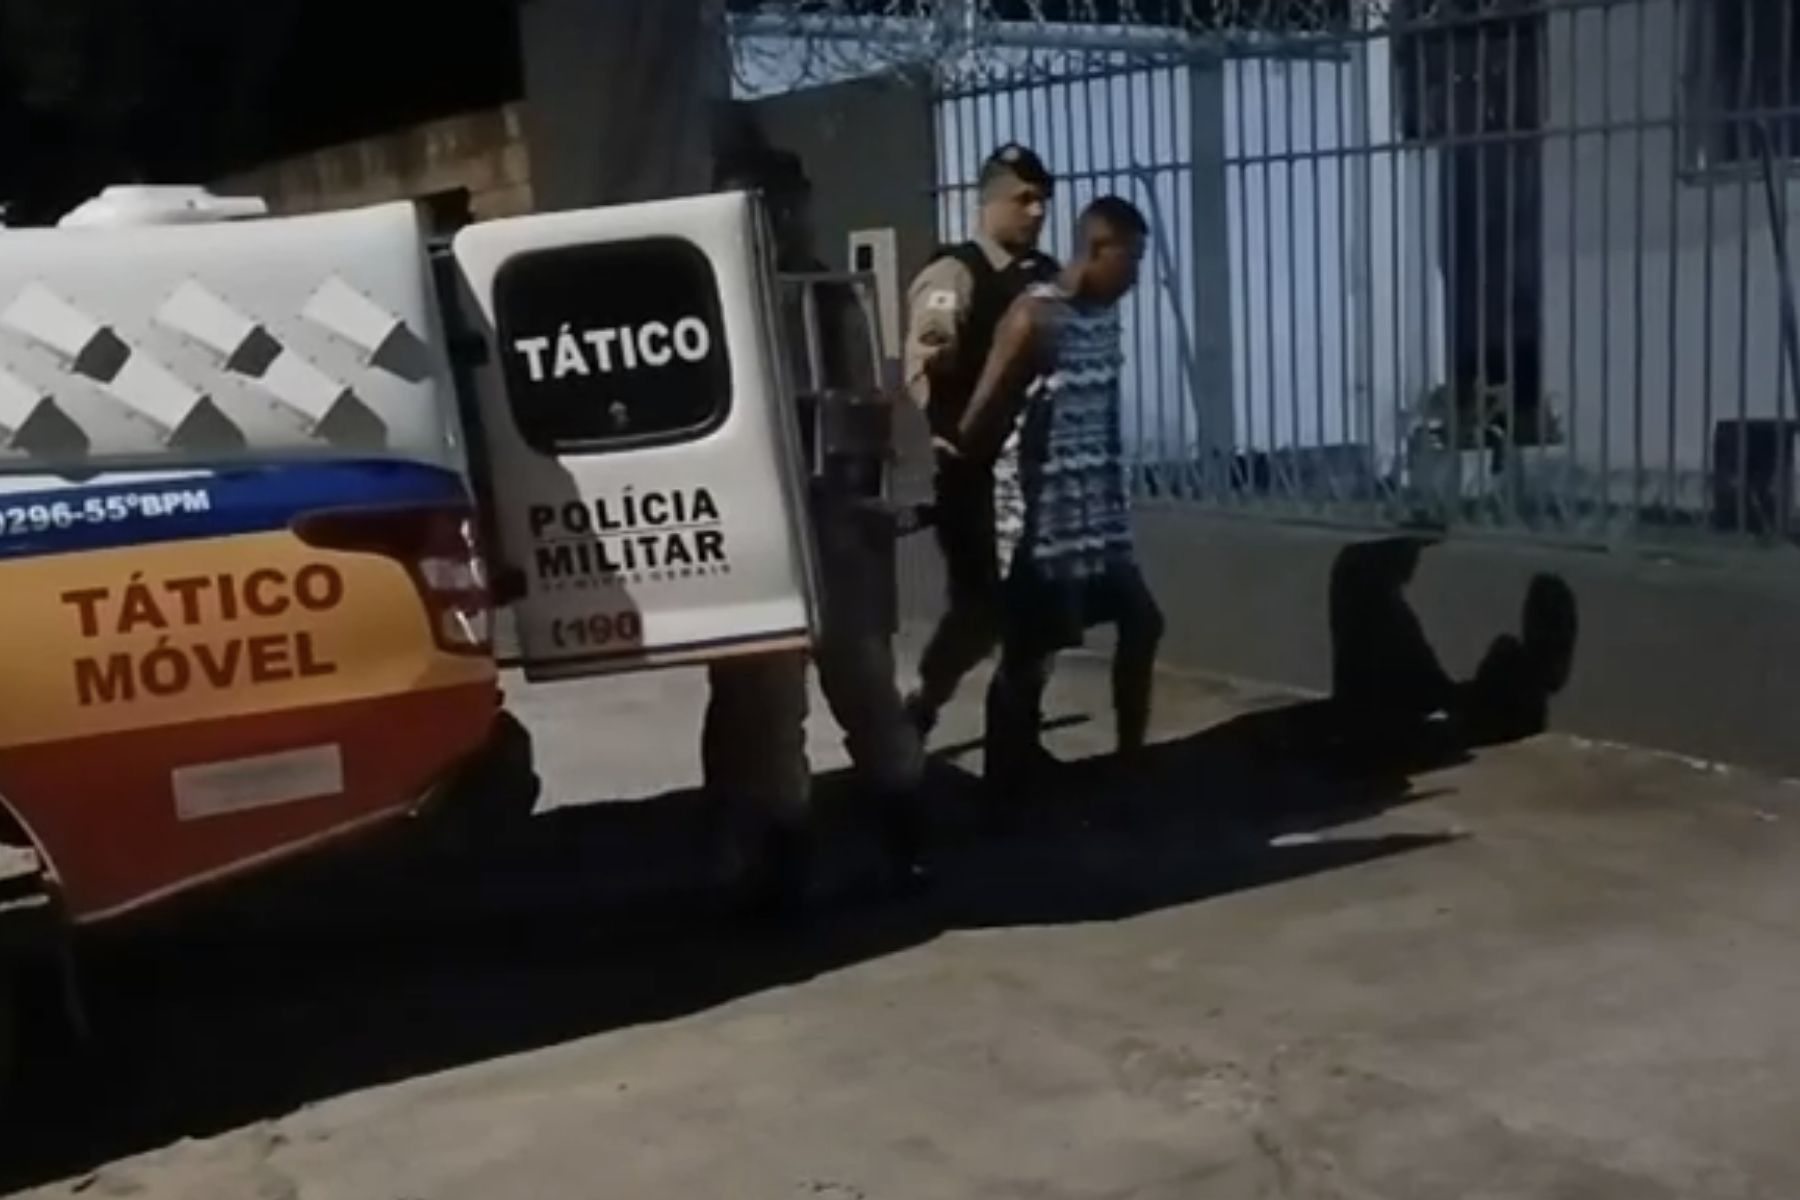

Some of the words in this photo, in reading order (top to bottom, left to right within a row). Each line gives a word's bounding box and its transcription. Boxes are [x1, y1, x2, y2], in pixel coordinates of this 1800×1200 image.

[514, 315, 710, 382] TÁTICO
[529, 485, 719, 538] POLÍCIA
[536, 530, 726, 578] MILITAR
[61, 563, 343, 637] TÁTICO
[74, 632, 337, 706] MÓVEL
